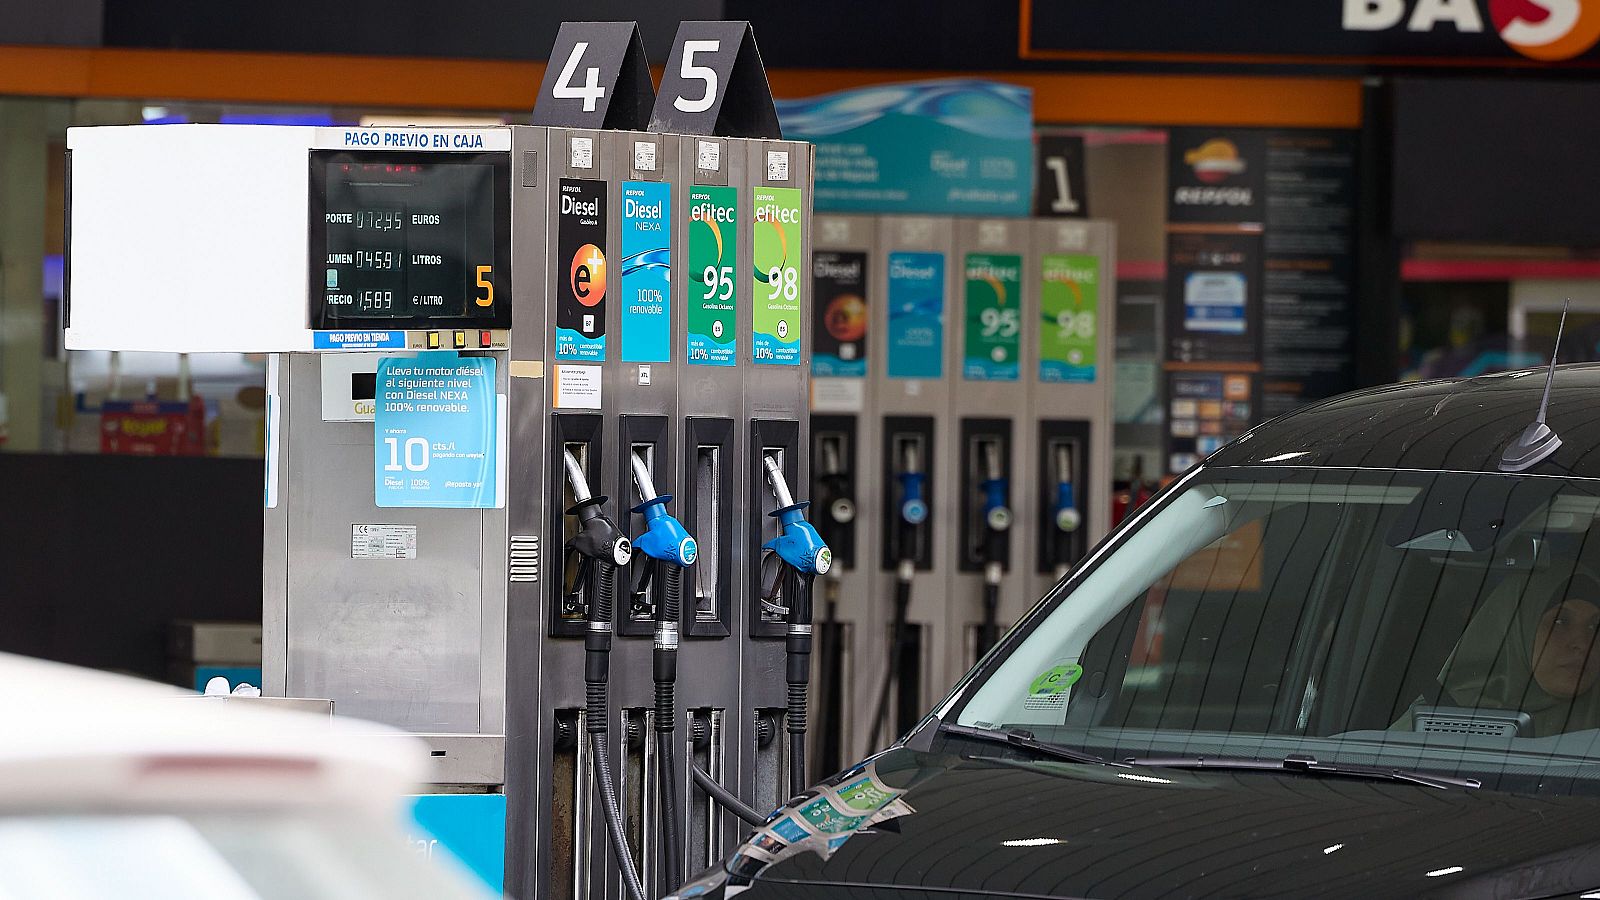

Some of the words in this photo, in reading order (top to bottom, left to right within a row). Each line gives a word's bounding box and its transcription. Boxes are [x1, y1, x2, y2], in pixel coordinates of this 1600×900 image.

[552, 42, 606, 112] 4
[673, 40, 720, 113] 5
[345, 132, 379, 146] PAGO
[384, 133, 428, 147] PREVIO
[433, 134, 449, 147] EN
[453, 135, 483, 148] CAJA
[1046, 156, 1079, 212] 1
[561, 194, 598, 216] Diesel
[625, 198, 662, 219] Diesel
[412, 215, 440, 225] EUROS
[691, 203, 735, 223] efitec
[756, 204, 799, 224] efitec
[635, 222, 662, 231] NEXA
[326, 254, 353, 263] UMEN
[412, 255, 442, 265] LITROS
[475, 265, 494, 307] 5
[703, 266, 734, 301] 95
[768, 266, 798, 301] 98
[637, 288, 663, 303] 100%
[629, 304, 663, 315] renovable
[980, 307, 1018, 338] 95
[329, 333, 344, 343] PAGO
[558, 343, 578, 355] 10%
[690, 348, 709, 360] 10%
[755, 348, 774, 360] 10%
[387, 366, 412, 376] Lleva
[413, 367, 424, 376] tu
[426, 366, 454, 376] motor
[456, 365, 484, 376] diésel
[386, 378, 396, 388] al
[398, 379, 444, 390] siguiente
[447, 378, 472, 388] nivel
[385, 392, 403, 400] con
[406, 390, 437, 400] Diesel
[440, 391, 468, 401] NEXA
[385, 403, 414, 412] 100%
[416, 402, 470, 413] renovable.
[432, 441, 456, 451] cts./l
[384, 437, 430, 472] 10
